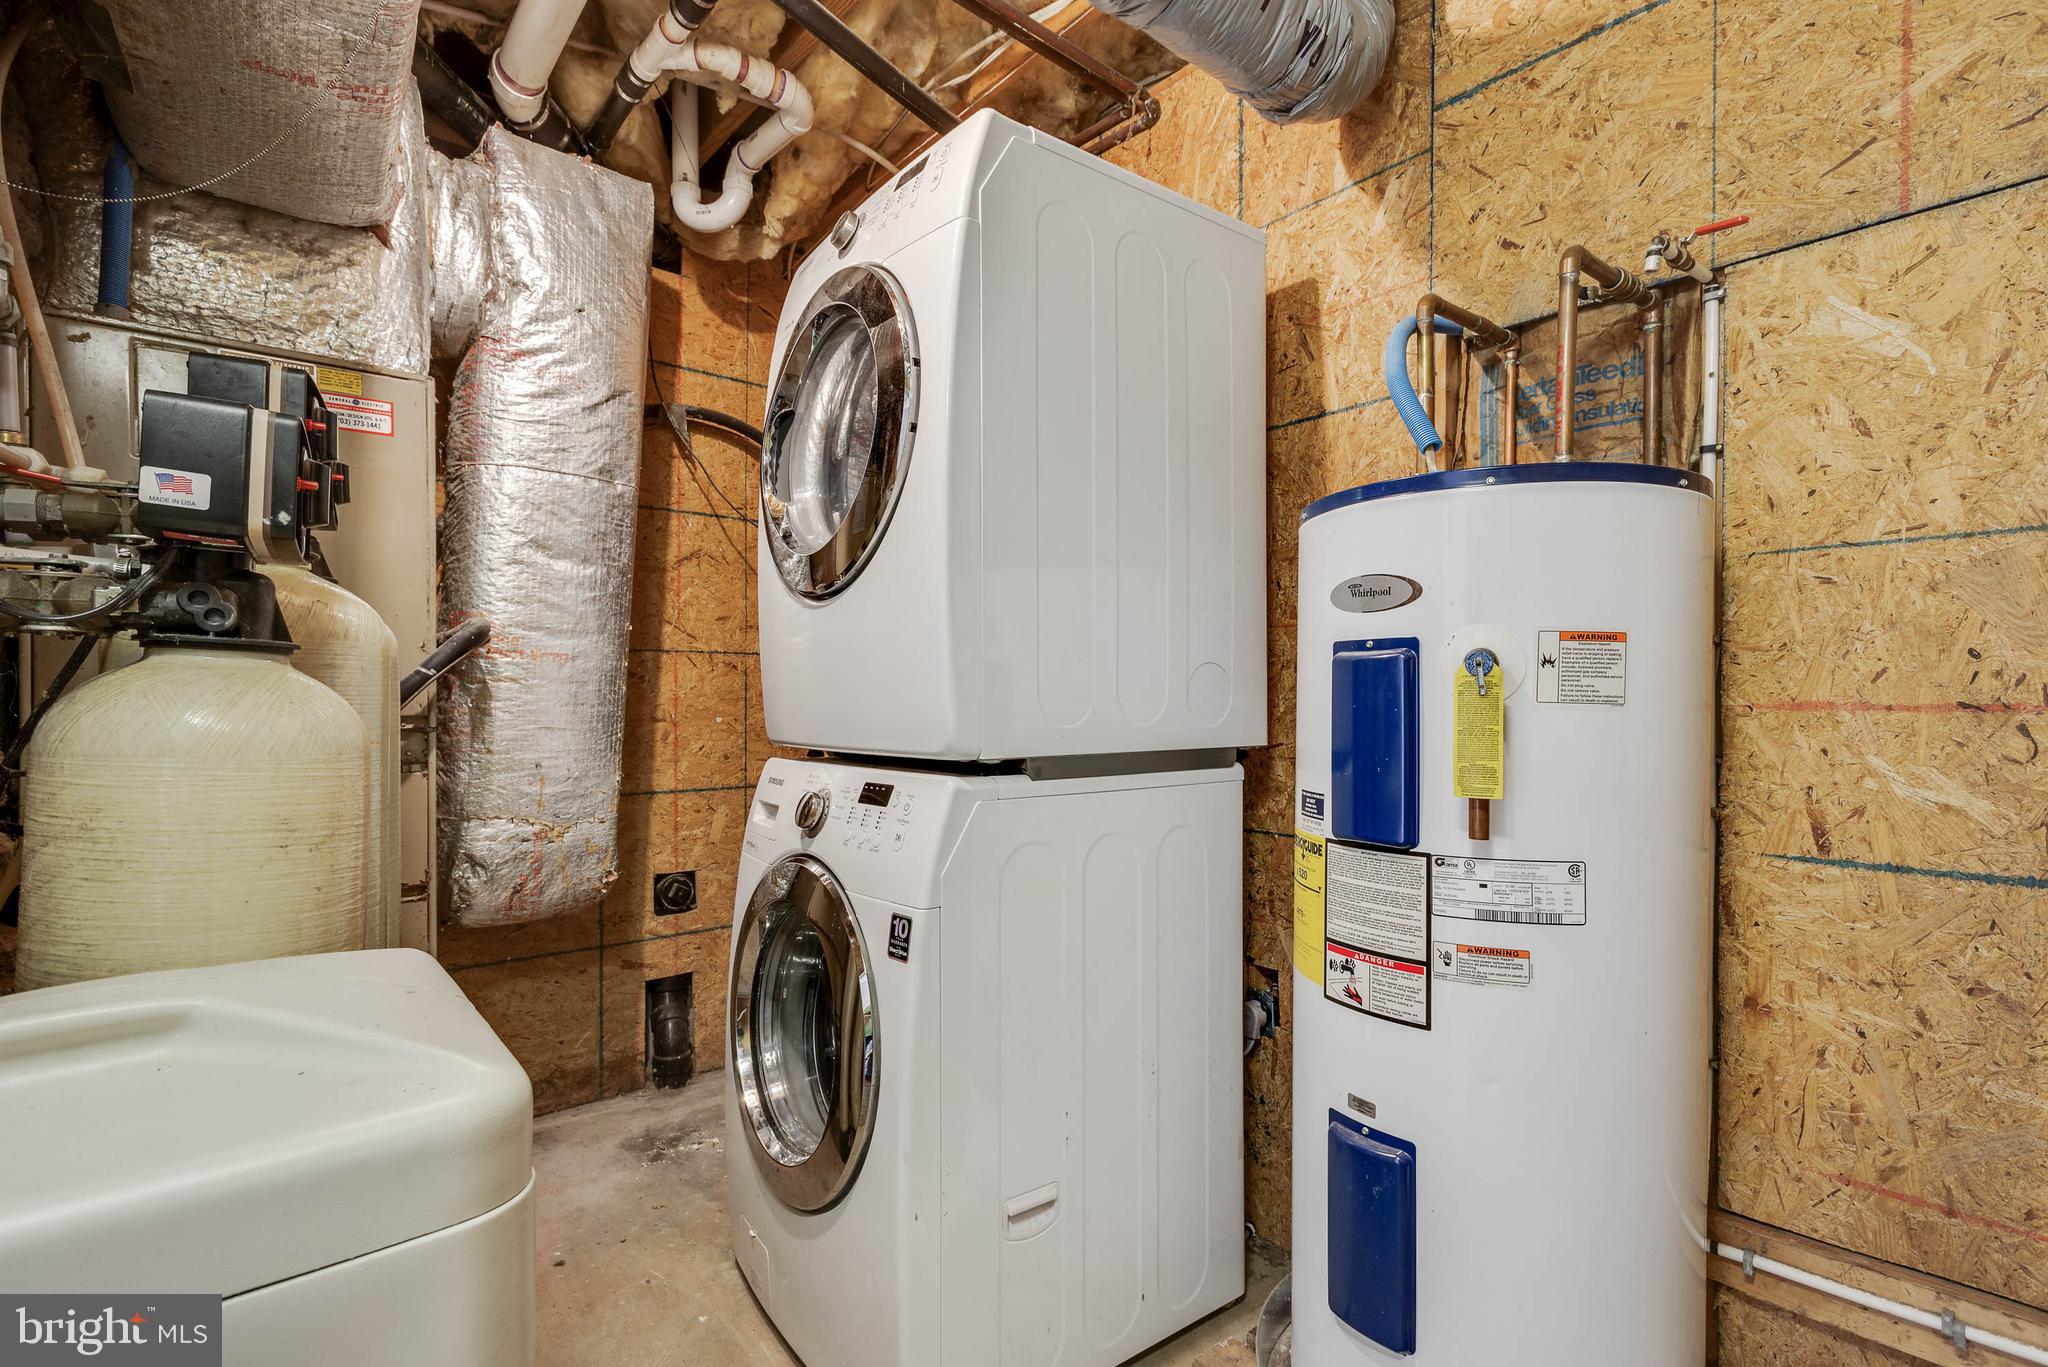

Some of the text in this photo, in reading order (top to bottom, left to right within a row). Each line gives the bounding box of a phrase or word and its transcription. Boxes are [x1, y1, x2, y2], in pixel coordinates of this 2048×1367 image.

[352, 420, 381, 430] 373-1441
[1350, 586, 1391, 599] Whirlpool
[893, 918, 908, 938] 10
[1474, 947, 1519, 957] WARNING
[1360, 953, 1394, 967] DANGER
